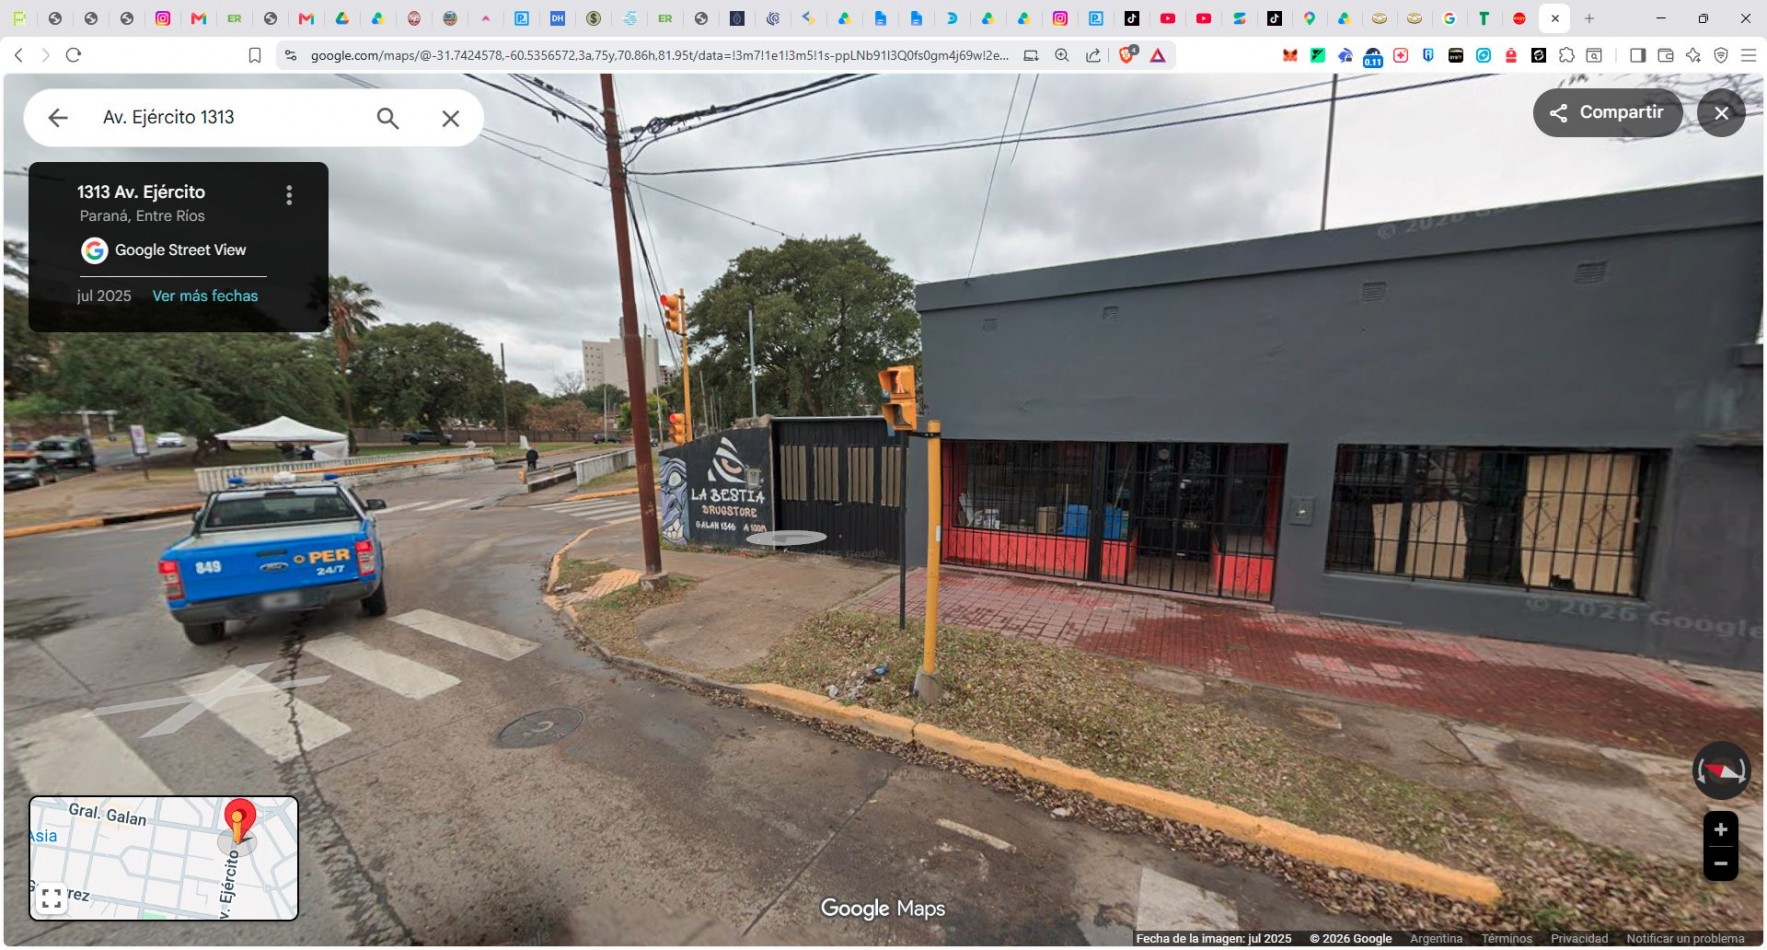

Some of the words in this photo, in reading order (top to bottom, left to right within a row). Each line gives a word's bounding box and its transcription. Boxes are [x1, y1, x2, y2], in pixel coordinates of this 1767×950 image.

[551, 14, 565, 22] DH
[1364, 58, 1382, 66] 0.11
[691, 488, 707, 501] LA
[710, 488, 766, 504] BESTIA
[701, 504, 758, 518] DRUGSTORE
[695, 521, 719, 530] GALAN
[309, 548, 350, 565] PER
[194, 560, 222, 575] 849
[316, 564, 346, 576] 24/7
